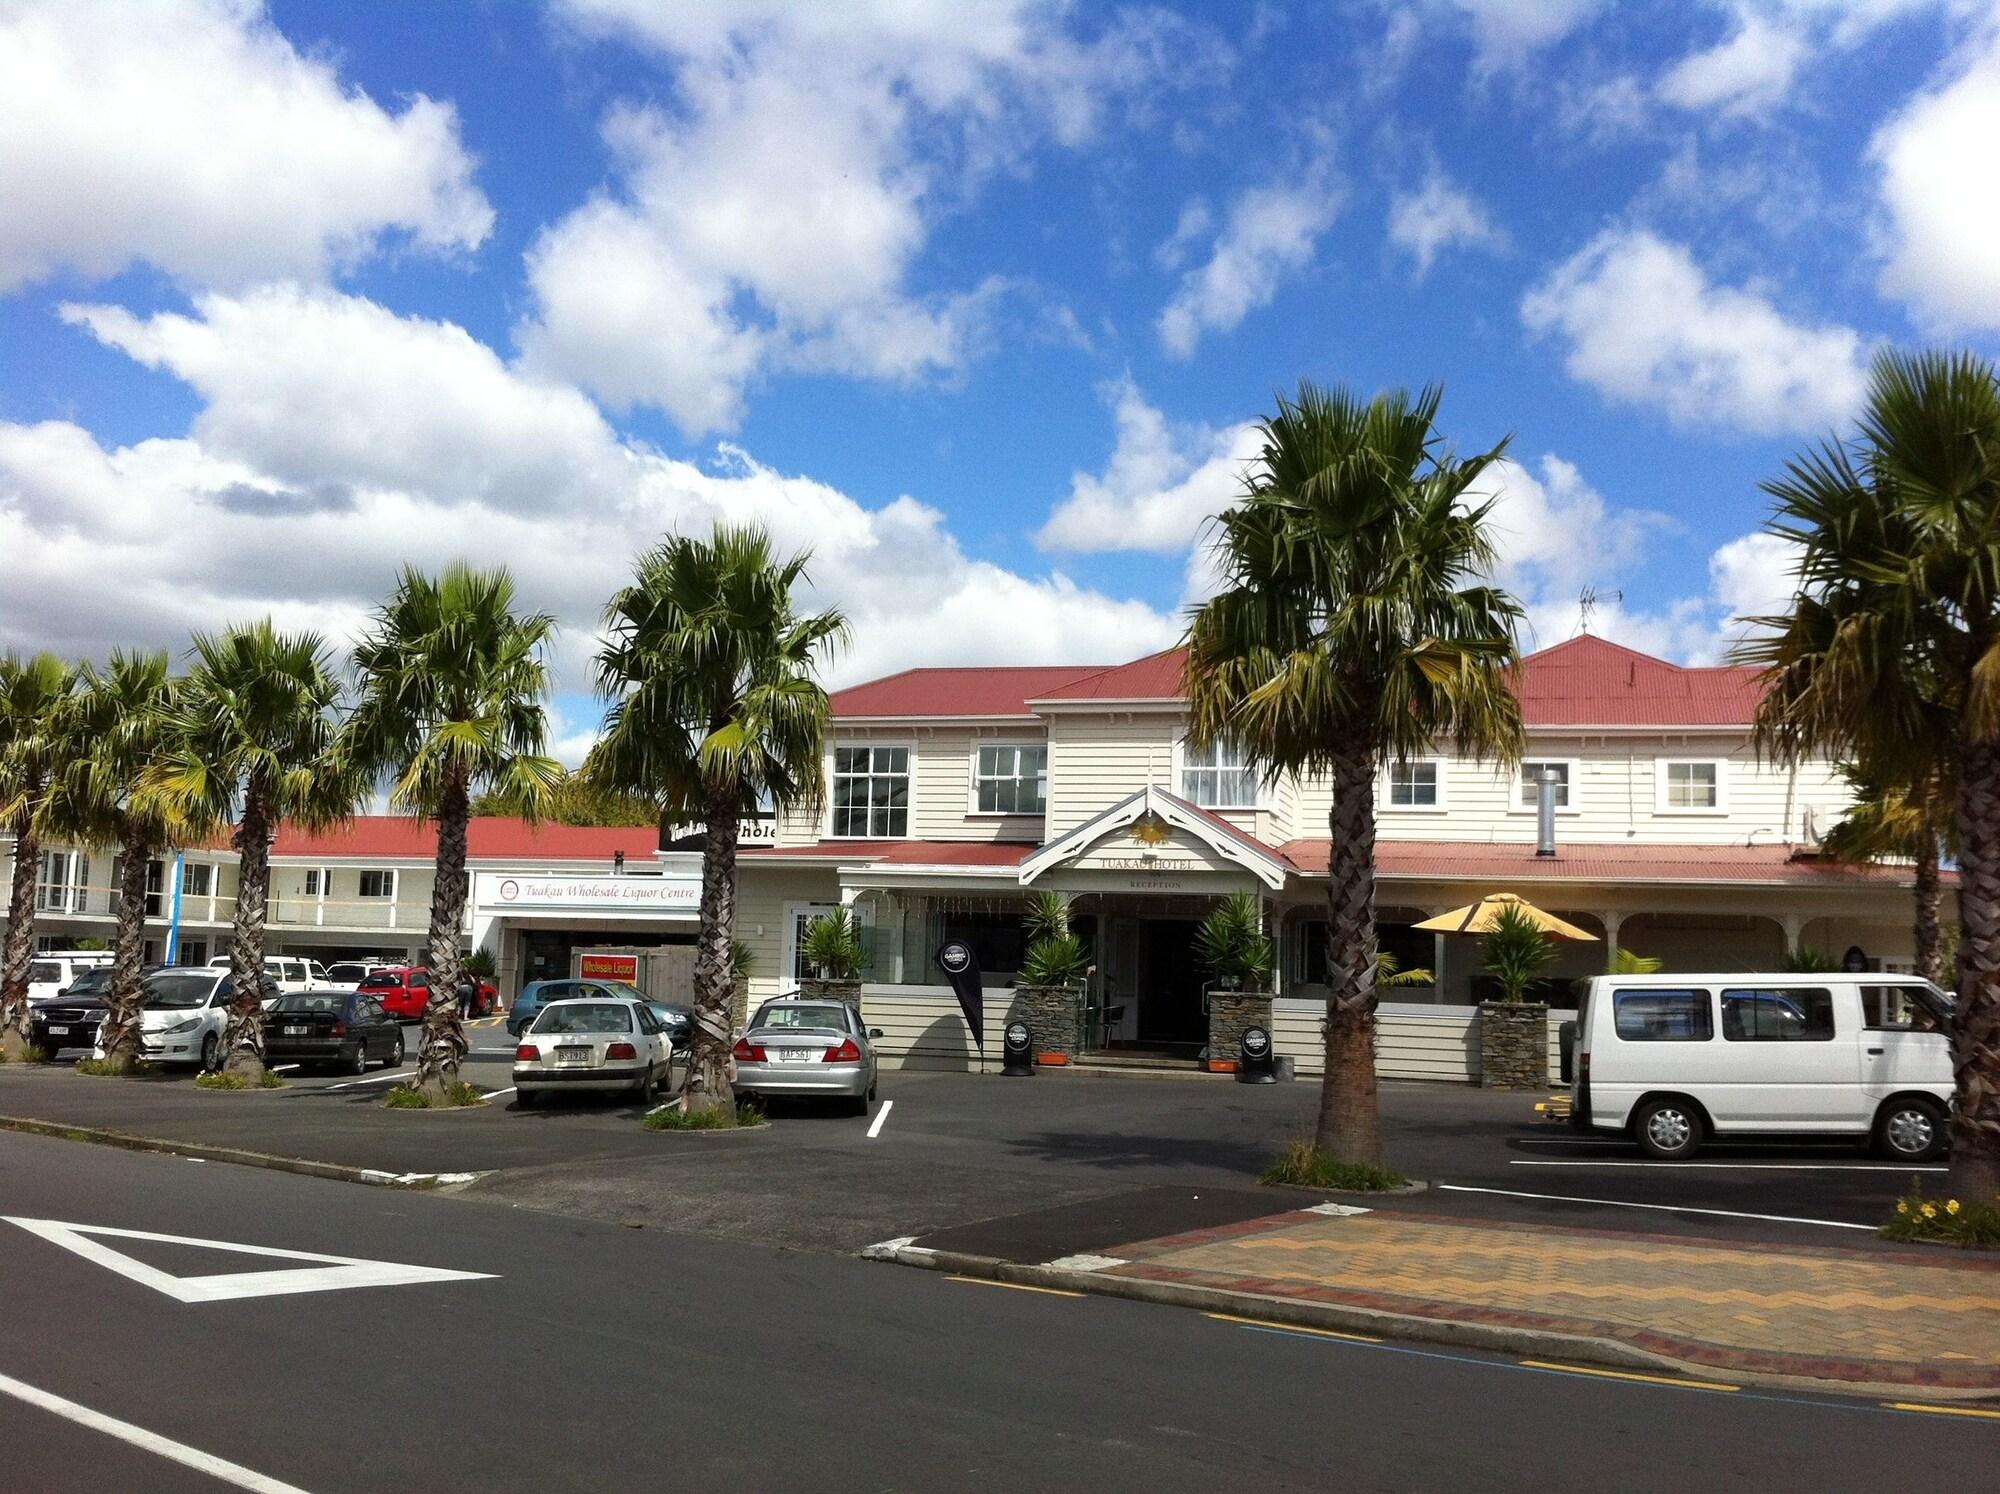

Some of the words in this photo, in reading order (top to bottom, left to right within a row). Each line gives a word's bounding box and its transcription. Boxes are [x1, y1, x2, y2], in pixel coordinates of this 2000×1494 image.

[1154, 859, 1194, 870] HOTEL
[1130, 881, 1181, 889] RECEPTION
[524, 884, 563, 898] Tuakau
[567, 883, 620, 898] Wholesale
[622, 886, 659, 901] Liquor
[660, 886, 695, 899] Centre
[583, 961, 612, 974] Wholesale
[613, 962, 634, 976] Liquor
